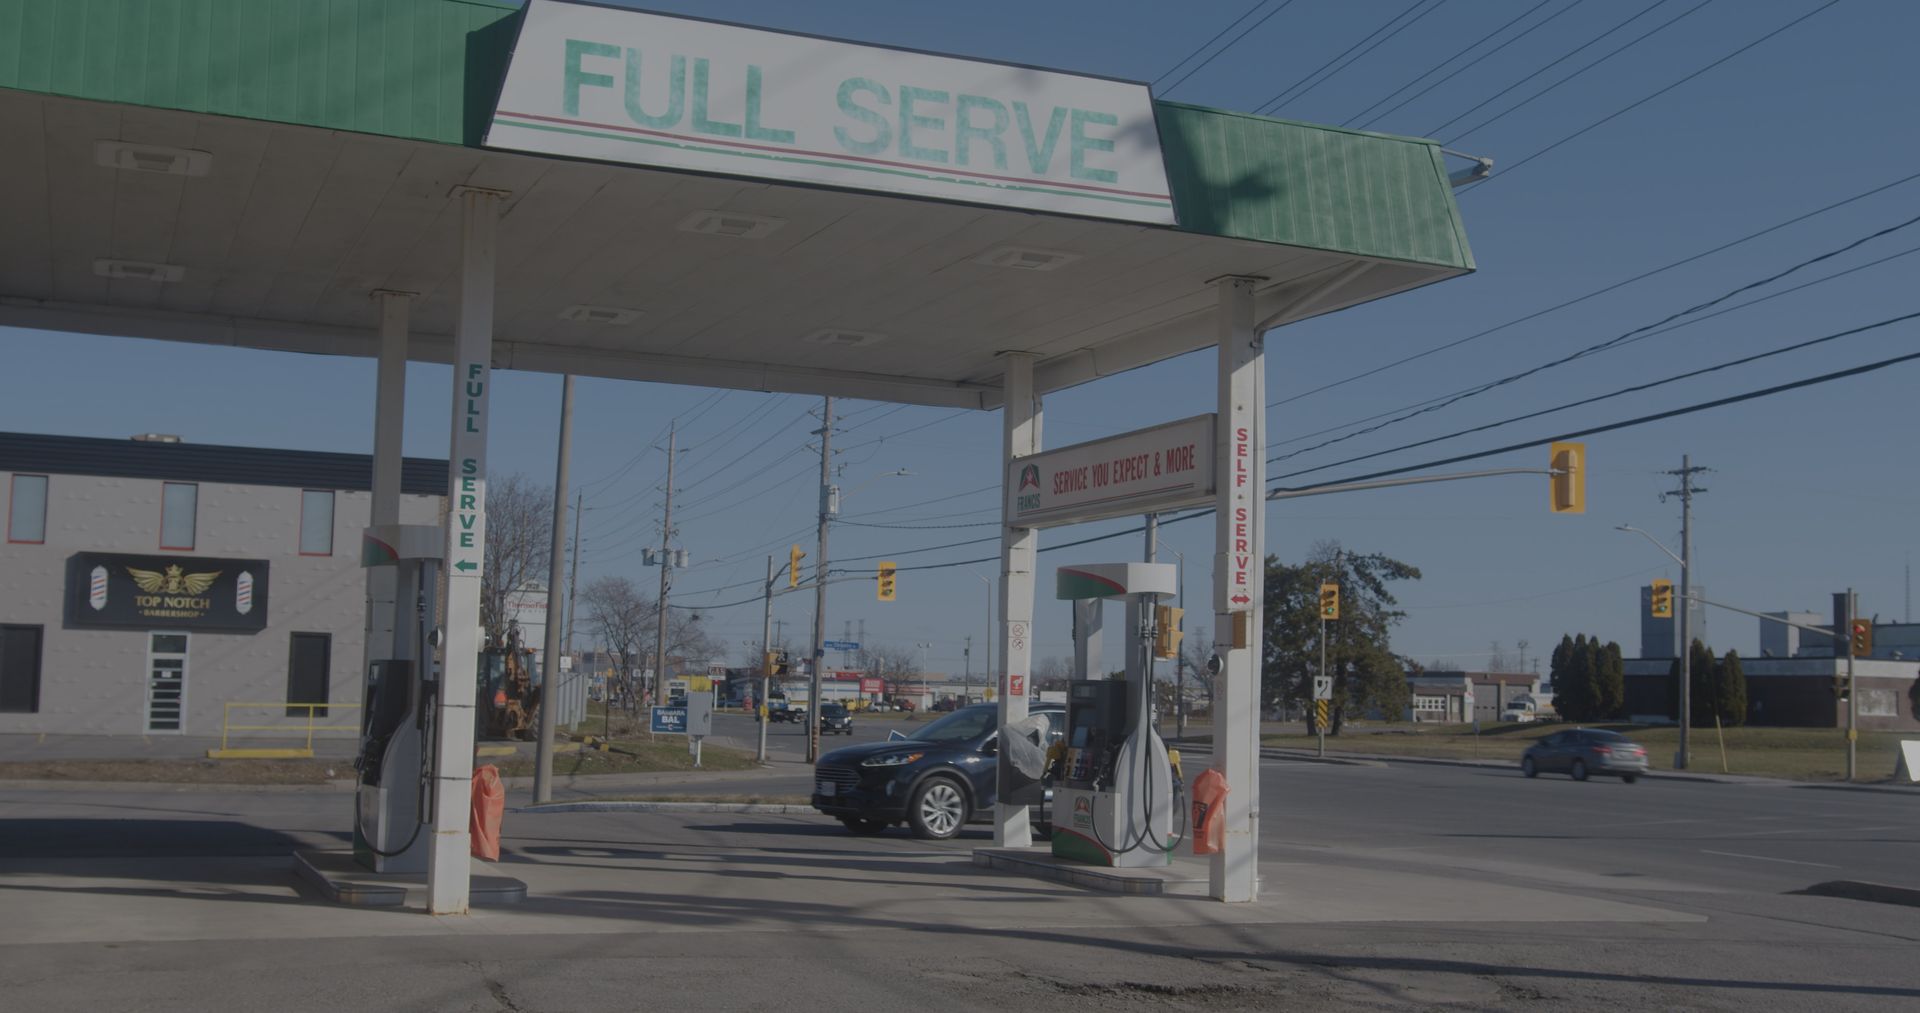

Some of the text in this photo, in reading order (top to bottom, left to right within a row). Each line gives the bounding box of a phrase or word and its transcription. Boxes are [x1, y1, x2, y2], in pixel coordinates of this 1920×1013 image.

[564, 39, 1118, 183] FULL SERVE
[459, 363, 483, 548] FULL SERVE
[1053, 444, 1195, 496] SERVICE YOU EXPECT & MORE
[1017, 493, 1041, 511] FRANCIS
[1235, 428, 1248, 585] SELF SERVE
[134, 596, 210, 609] TOP NOTCH
[661, 715, 681, 724] BAL
